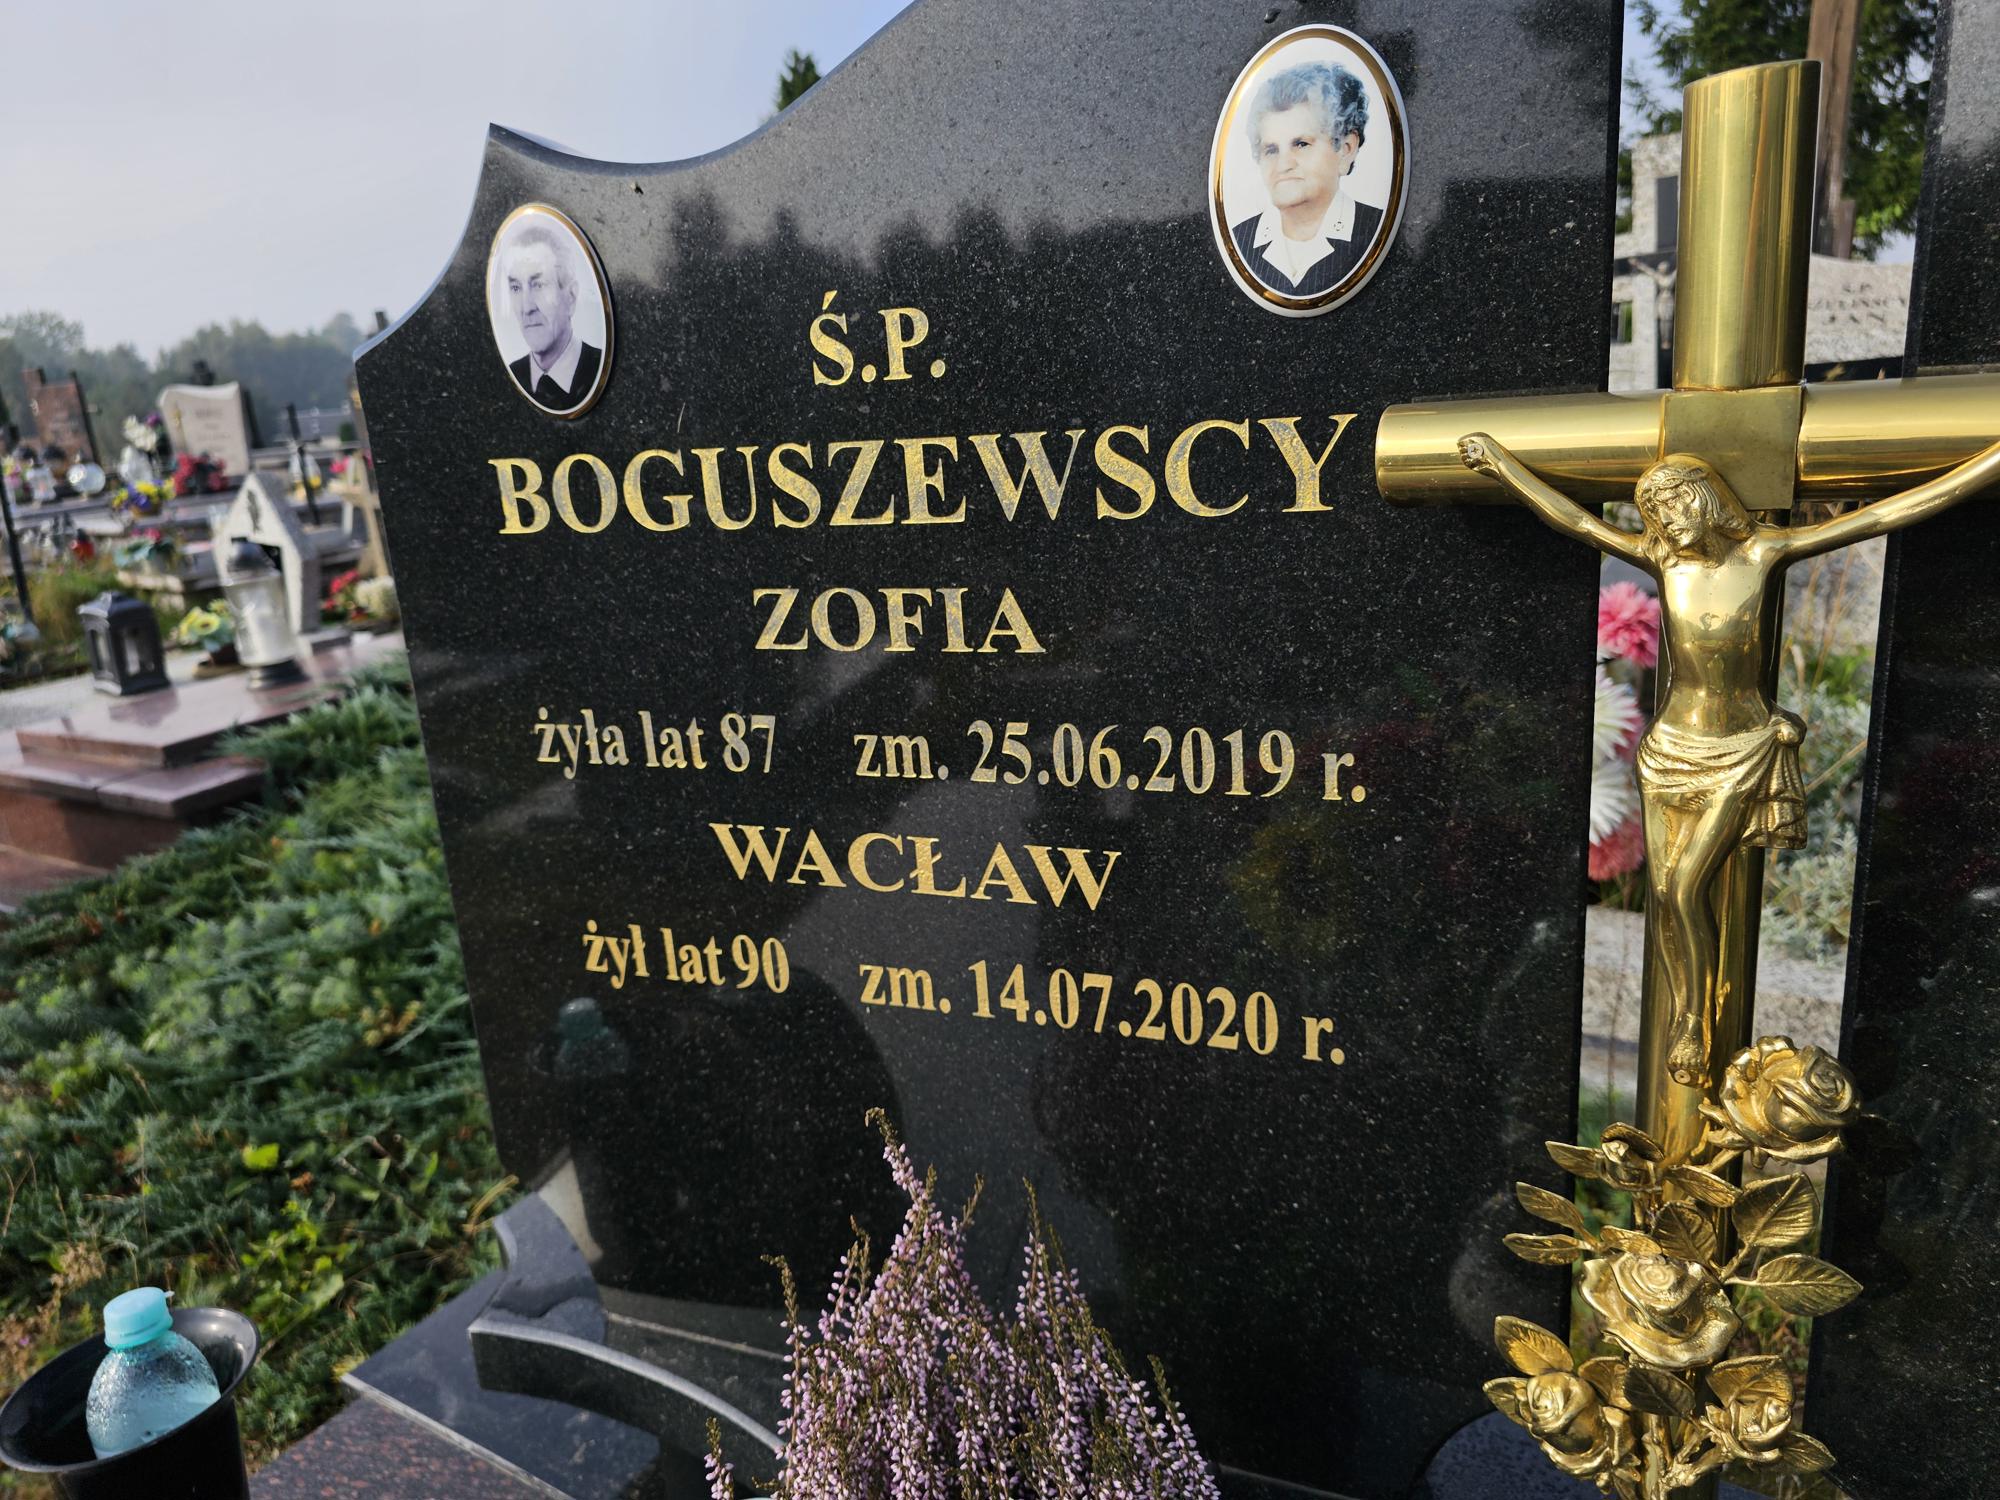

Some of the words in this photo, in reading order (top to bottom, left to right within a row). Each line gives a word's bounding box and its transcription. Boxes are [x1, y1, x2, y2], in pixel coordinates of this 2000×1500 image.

[810, 290, 945, 386] Ś.P.
[488, 413, 1358, 534] BOGUSZEWSCY
[753, 587, 1044, 653] ZOFIA
[533, 708, 629, 778] żyła
[640, 711, 707, 769] lat
[720, 713, 773, 773] 87
[854, 735, 947, 779] zm.
[968, 720, 1295, 797] 25.06.2019
[1323, 753, 1366, 802] r.
[709, 823, 1120, 910] WACŁAW
[582, 920, 650, 989] żył
[660, 928, 726, 986] lat
[732, 935, 789, 993] 90
[859, 964, 951, 1014] zm.
[969, 960, 1278, 1055] 14.07.2020
[1302, 1017, 1344, 1065] r.
